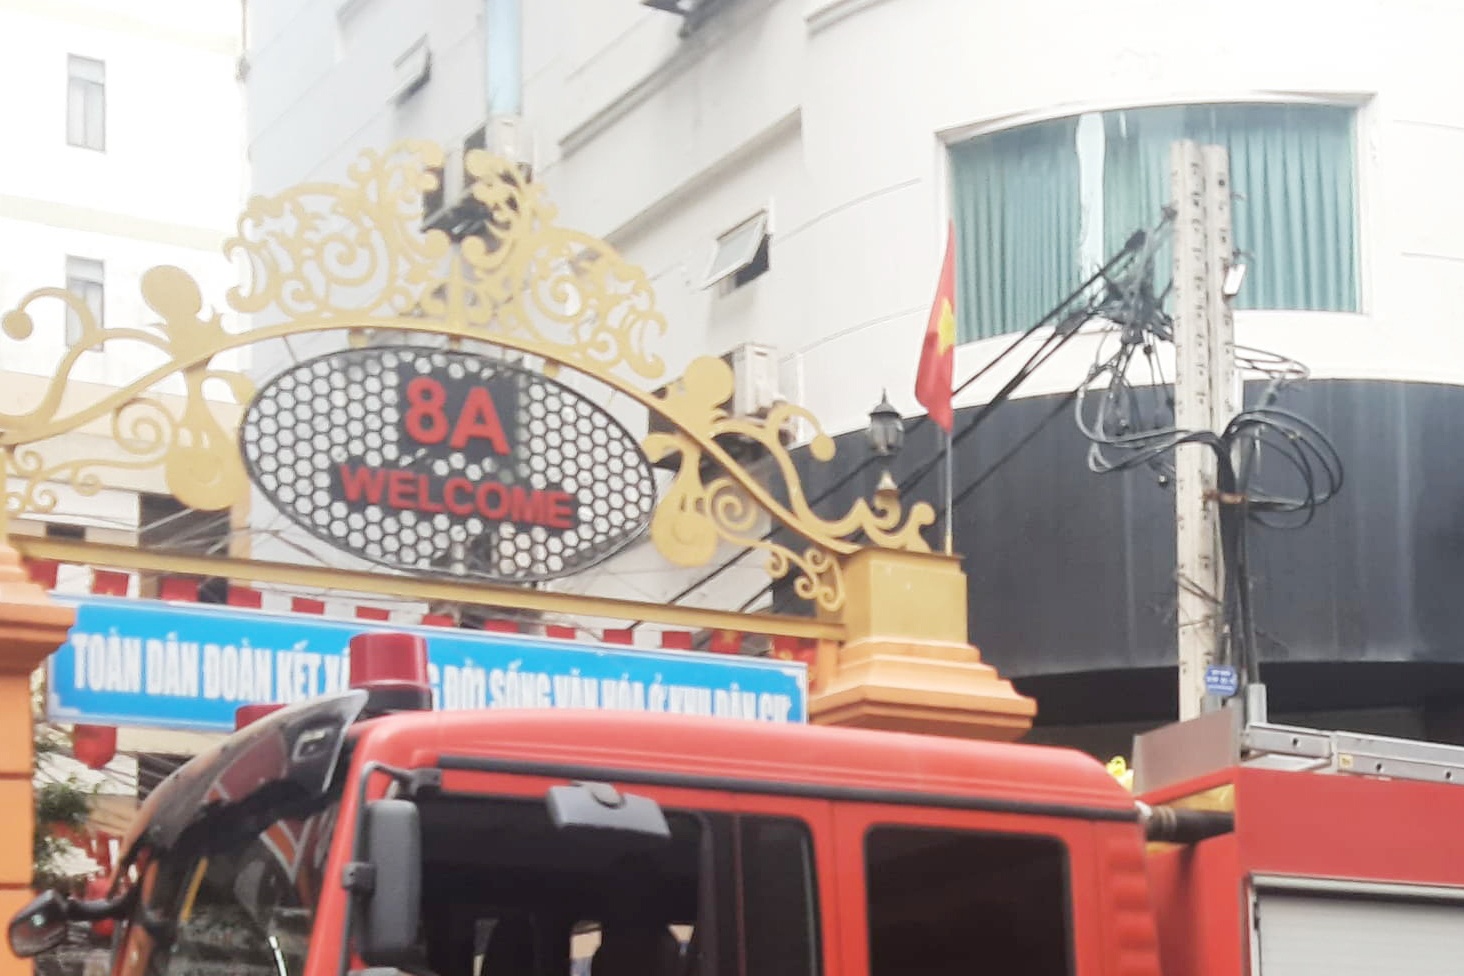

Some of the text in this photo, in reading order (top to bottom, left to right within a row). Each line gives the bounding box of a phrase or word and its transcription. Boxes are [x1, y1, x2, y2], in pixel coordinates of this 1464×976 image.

[405, 376, 511, 456] 8A
[339, 463, 574, 530] WELCOME
[71, 626, 142, 694] TOÀN
[145, 631, 199, 698] DÂN
[276, 640, 321, 704] KẾT
